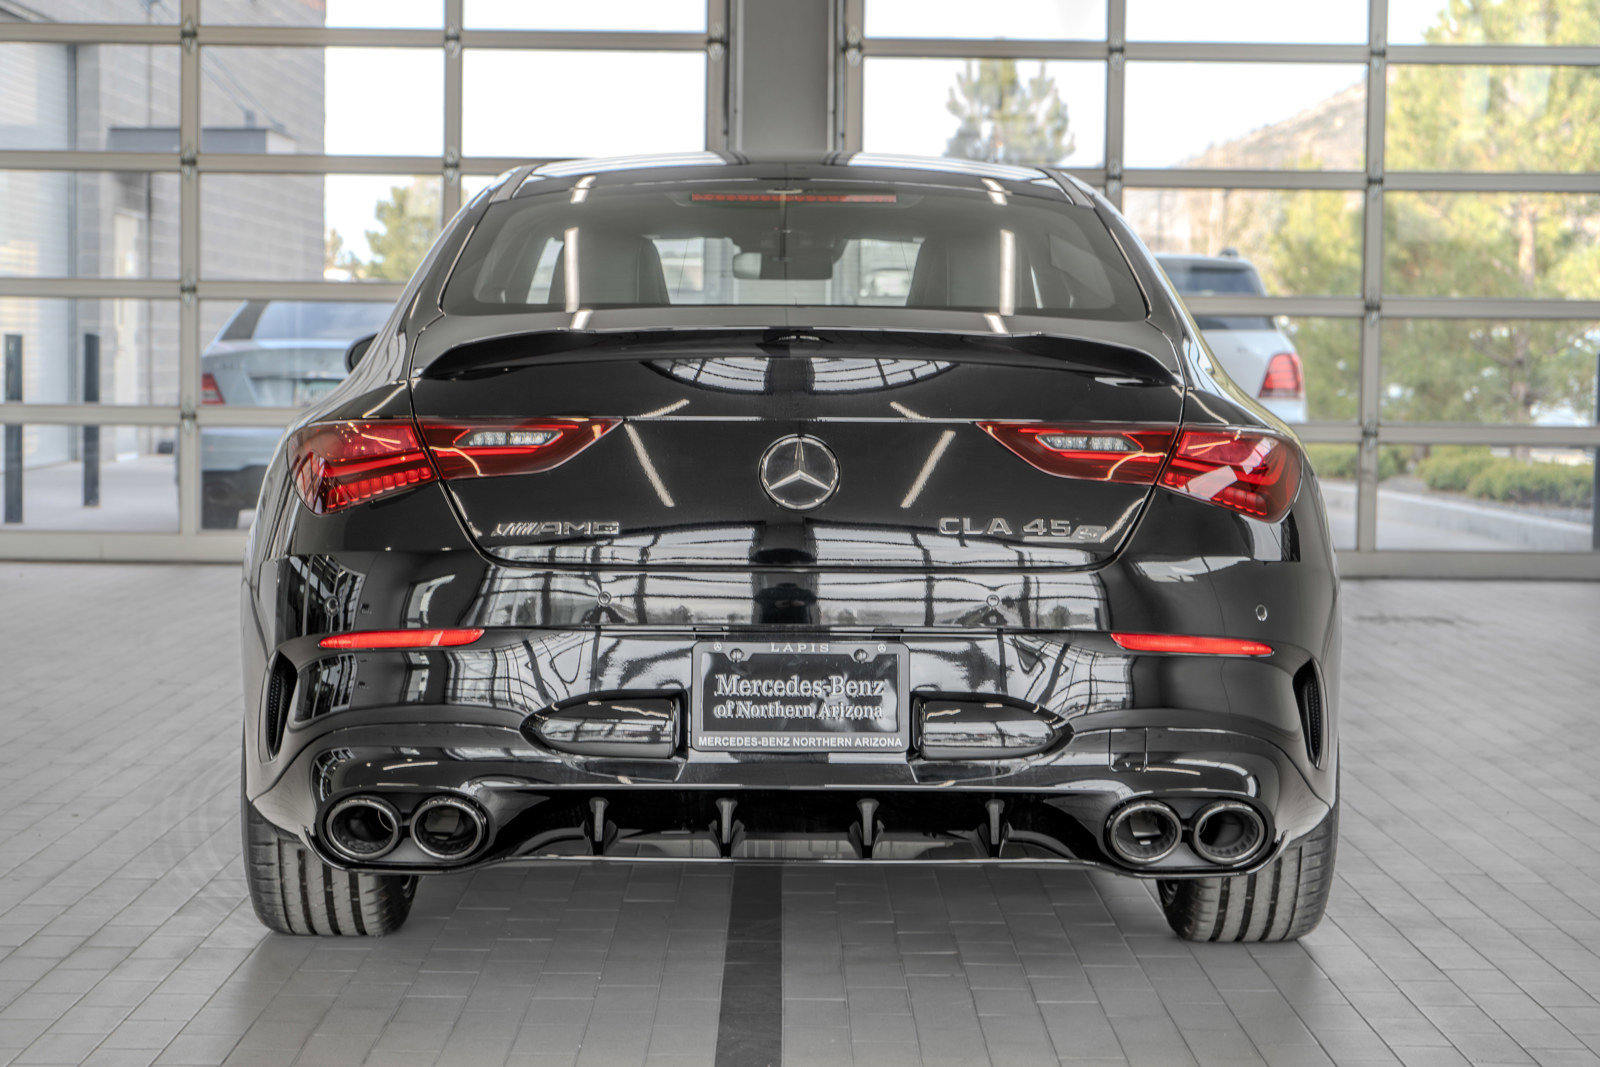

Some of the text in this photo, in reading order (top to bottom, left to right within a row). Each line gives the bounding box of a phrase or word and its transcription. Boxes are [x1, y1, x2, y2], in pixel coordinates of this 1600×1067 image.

[939, 517, 1012, 535] CLA
[1022, 518, 1071, 536] 45
[770, 643, 830, 653] LAPIS
[714, 673, 885, 697] Mercedes-Benz
[714, 700, 884, 719] of Northern Arizona
[698, 736, 903, 747] MERCEDES-BENZ NORTHERN ARIZONA
